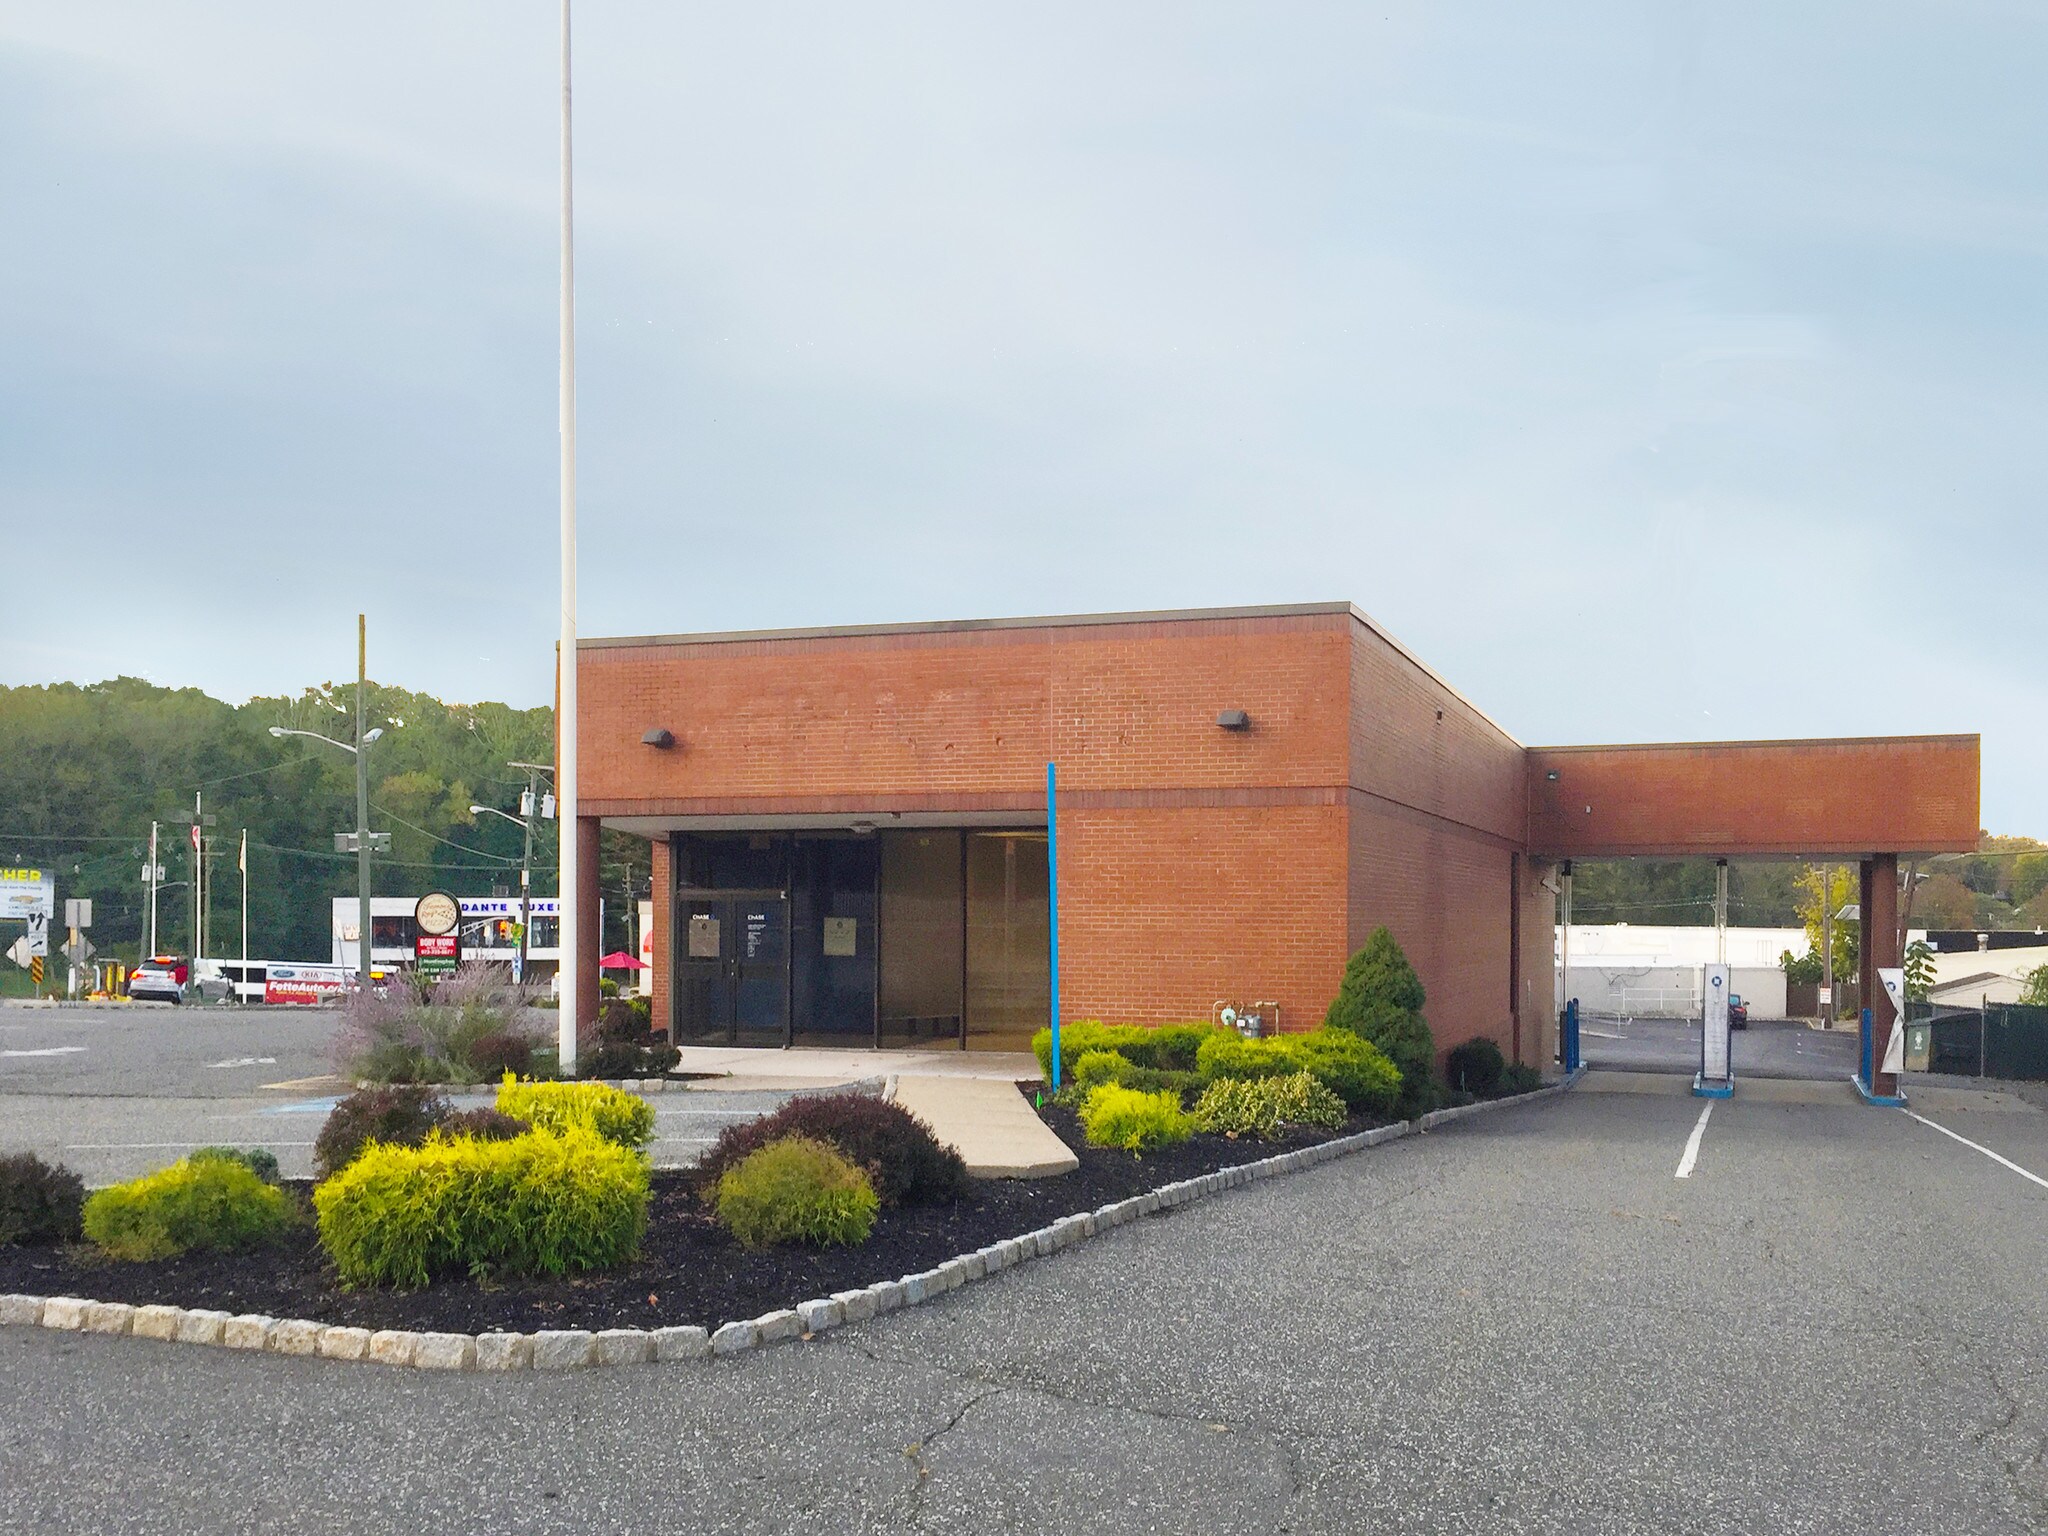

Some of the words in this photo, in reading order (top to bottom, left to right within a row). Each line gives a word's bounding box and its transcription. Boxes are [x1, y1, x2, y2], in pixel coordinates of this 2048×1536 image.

[0, 869, 42, 881] HER
[461, 903, 508, 912] DANTE
[518, 903, 559, 912] TUXE
